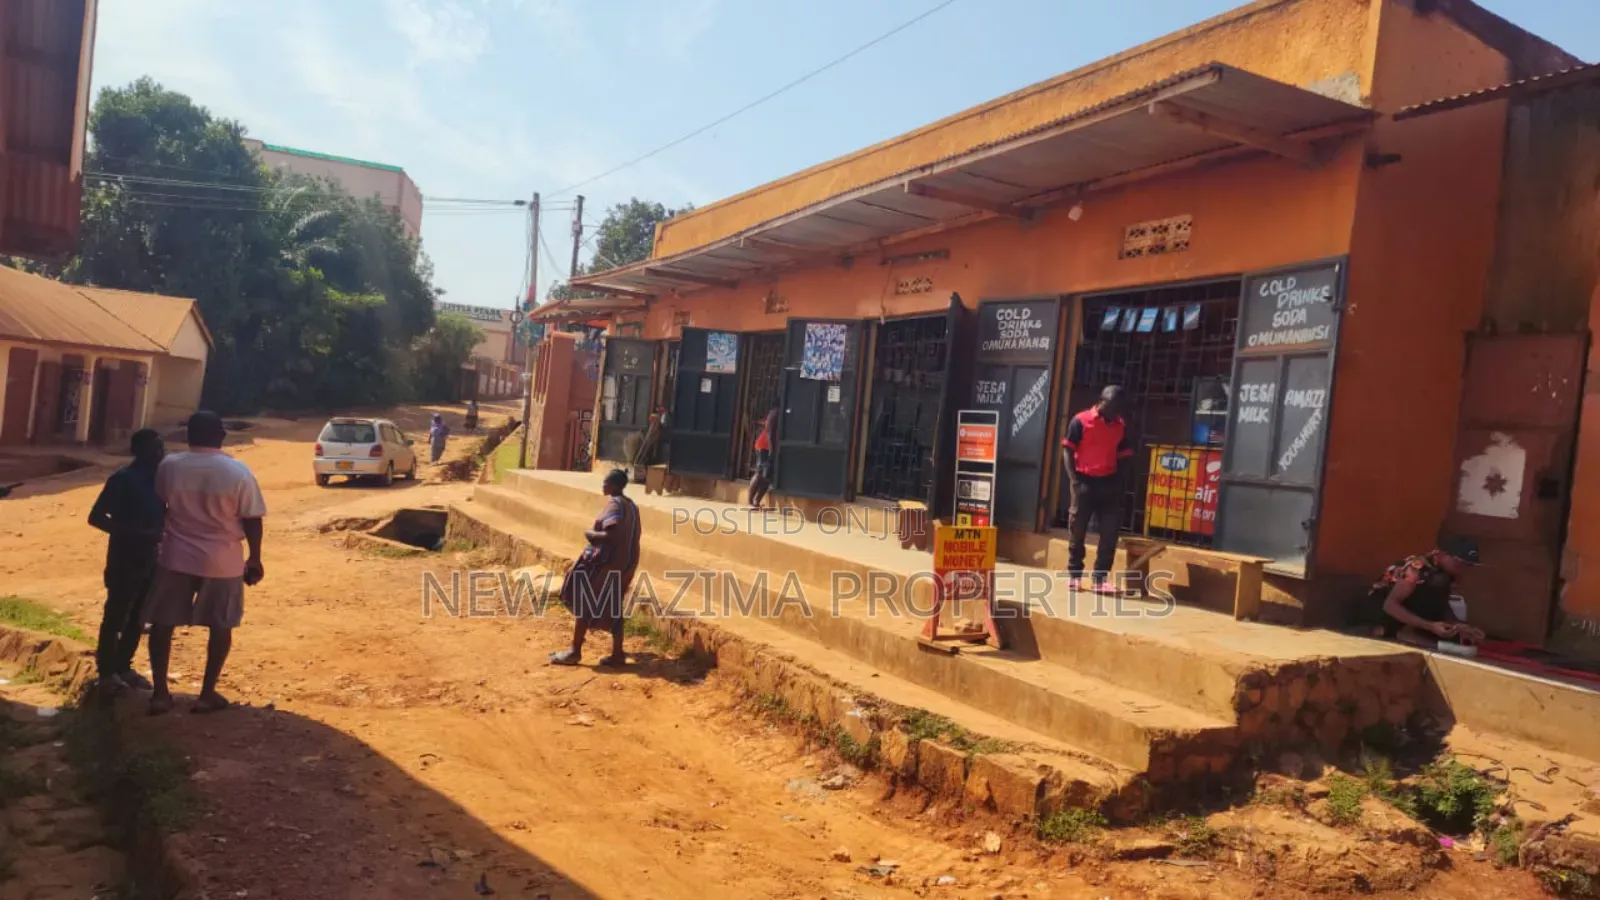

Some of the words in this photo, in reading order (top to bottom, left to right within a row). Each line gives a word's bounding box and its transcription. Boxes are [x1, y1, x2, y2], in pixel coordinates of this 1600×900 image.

[1259, 277, 1296, 297] COLD
[996, 307, 1031, 320] COLD
[1272, 308, 1307, 328] SODA
[998, 319, 1042, 331] DRINKS
[1000, 329, 1029, 340] SODA
[976, 393, 1003, 405] MILK
[1238, 406, 1269, 424] MILK
[1160, 456, 1186, 469] MTN
[1150, 473, 1196, 492] MOBILE
[1148, 494, 1195, 512] MONEY
[954, 529, 981, 540] MTN
[944, 540, 987, 552] MOBILE
[943, 555, 985, 568] MONEY
